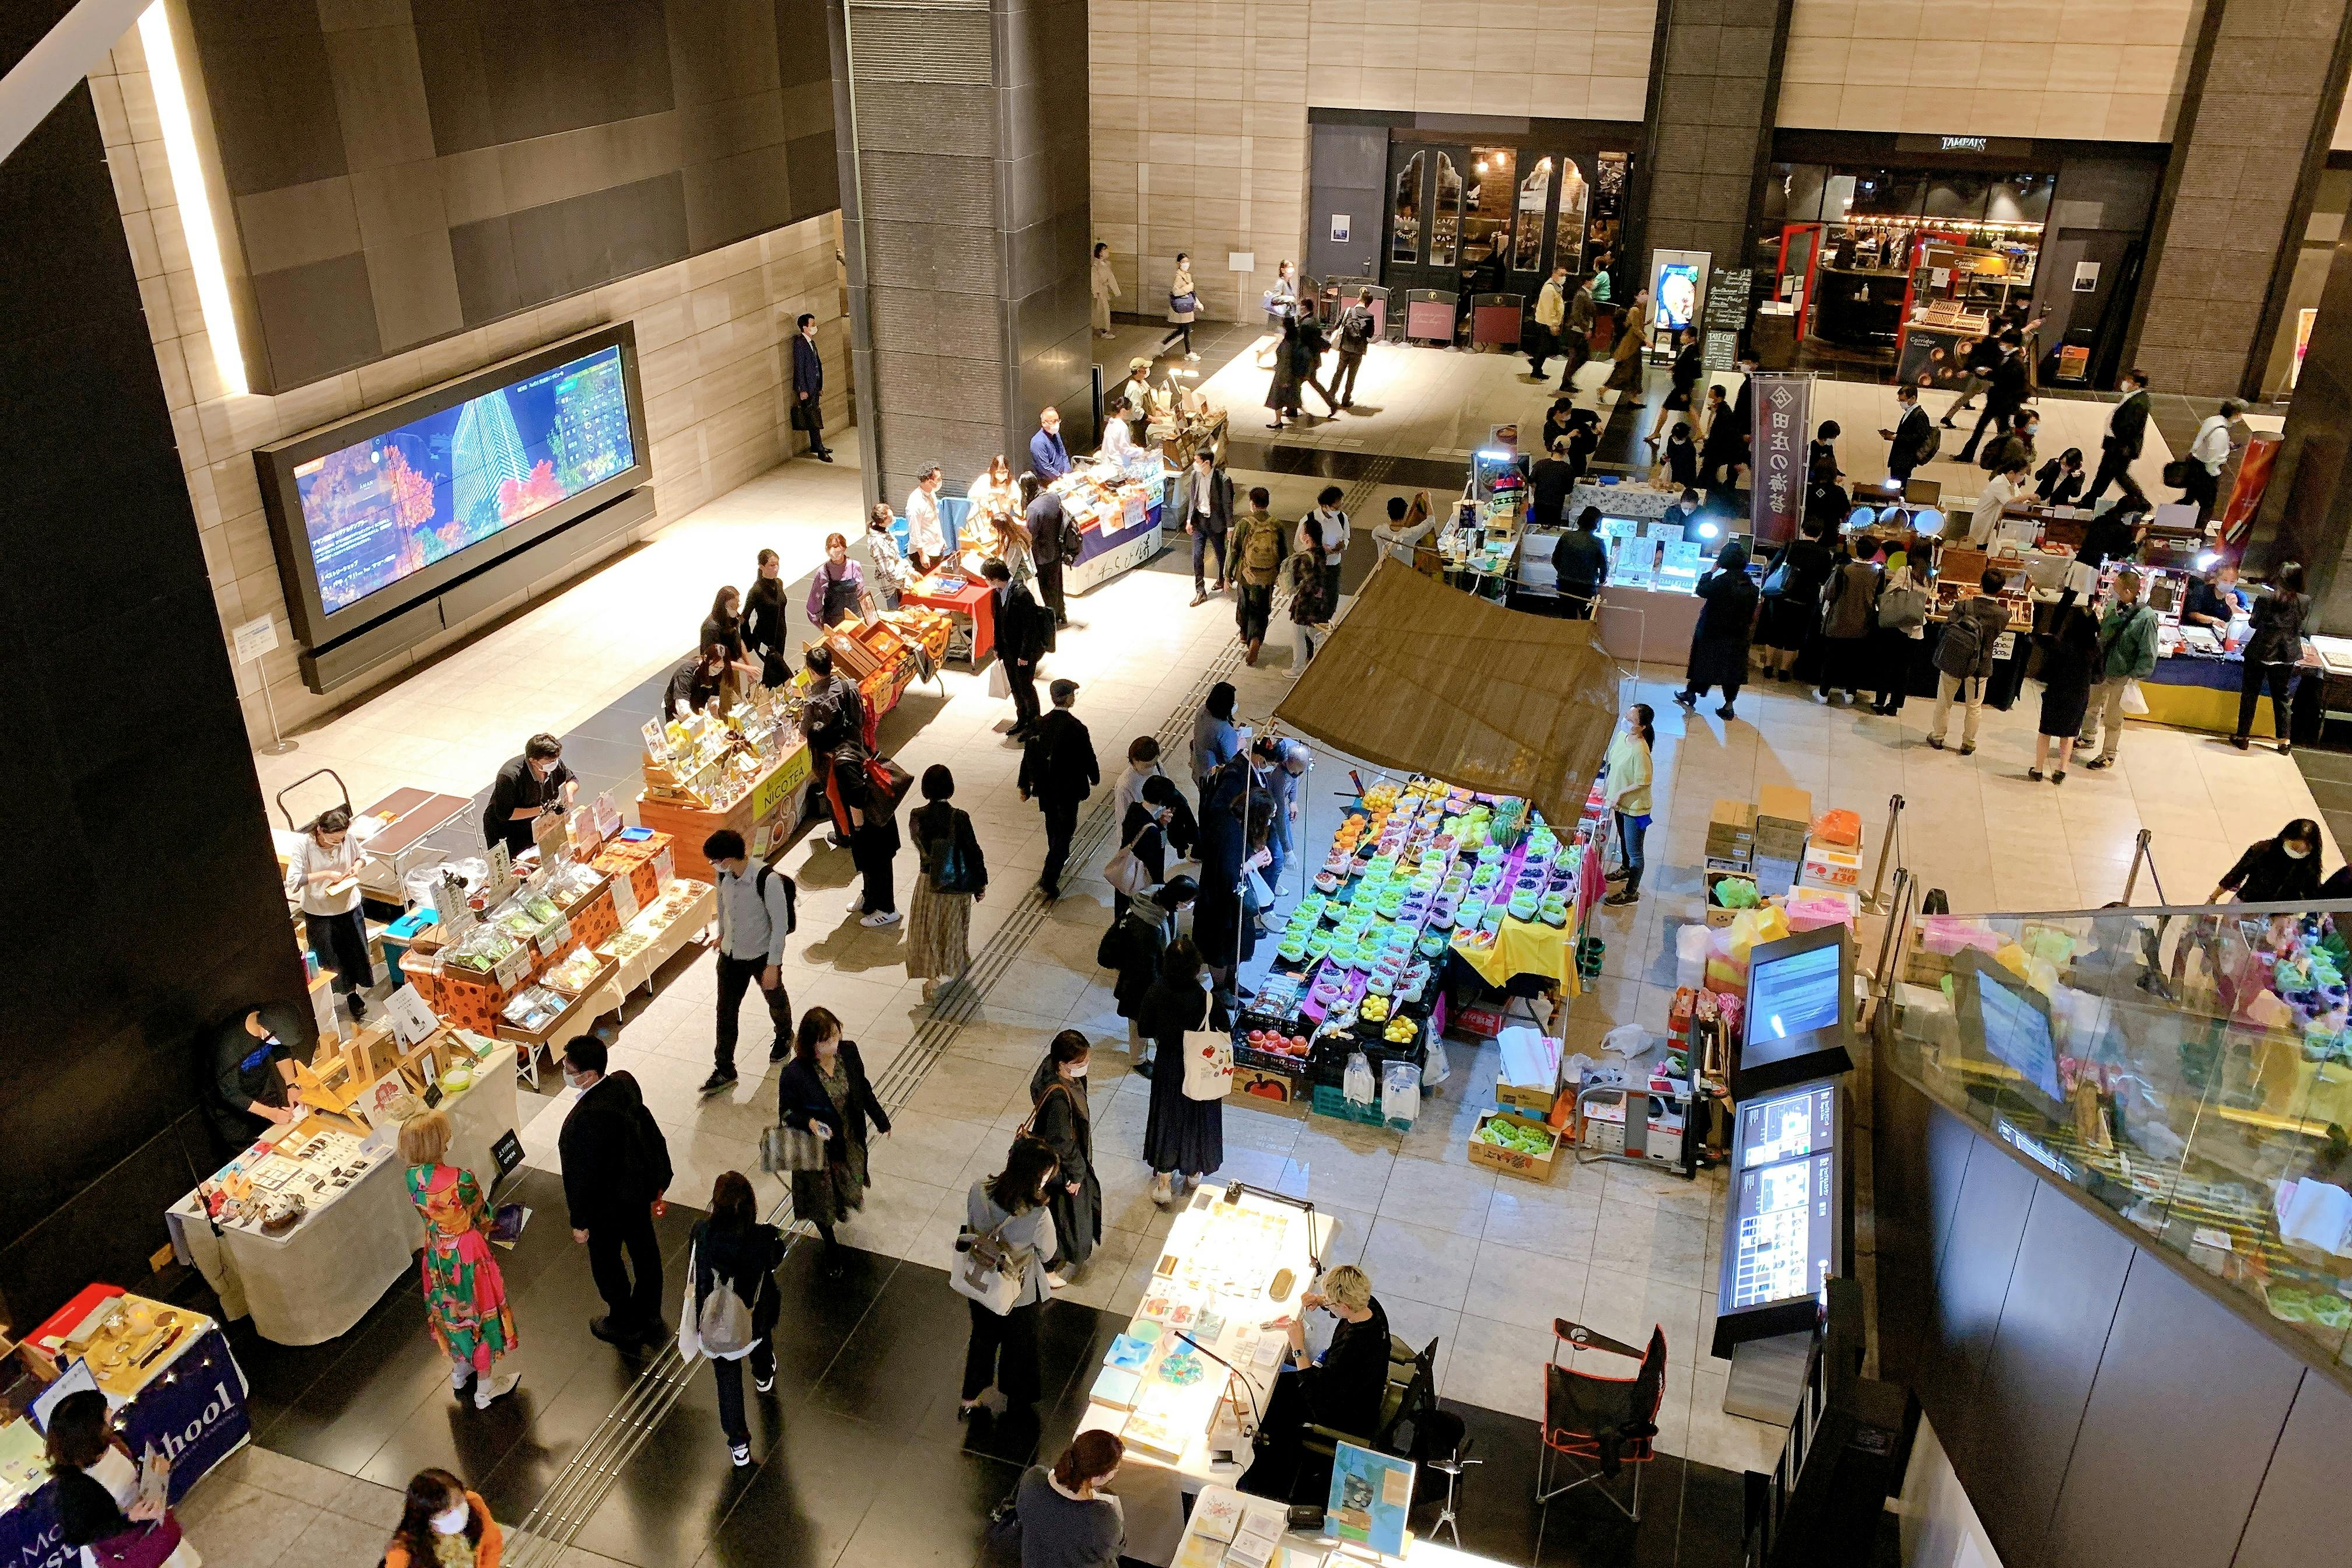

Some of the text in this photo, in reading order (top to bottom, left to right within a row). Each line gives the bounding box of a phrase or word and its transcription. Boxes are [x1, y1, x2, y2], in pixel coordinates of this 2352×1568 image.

[1098, 533, 1150, 580] わらび餅
[138, 1381, 236, 1463] hool
